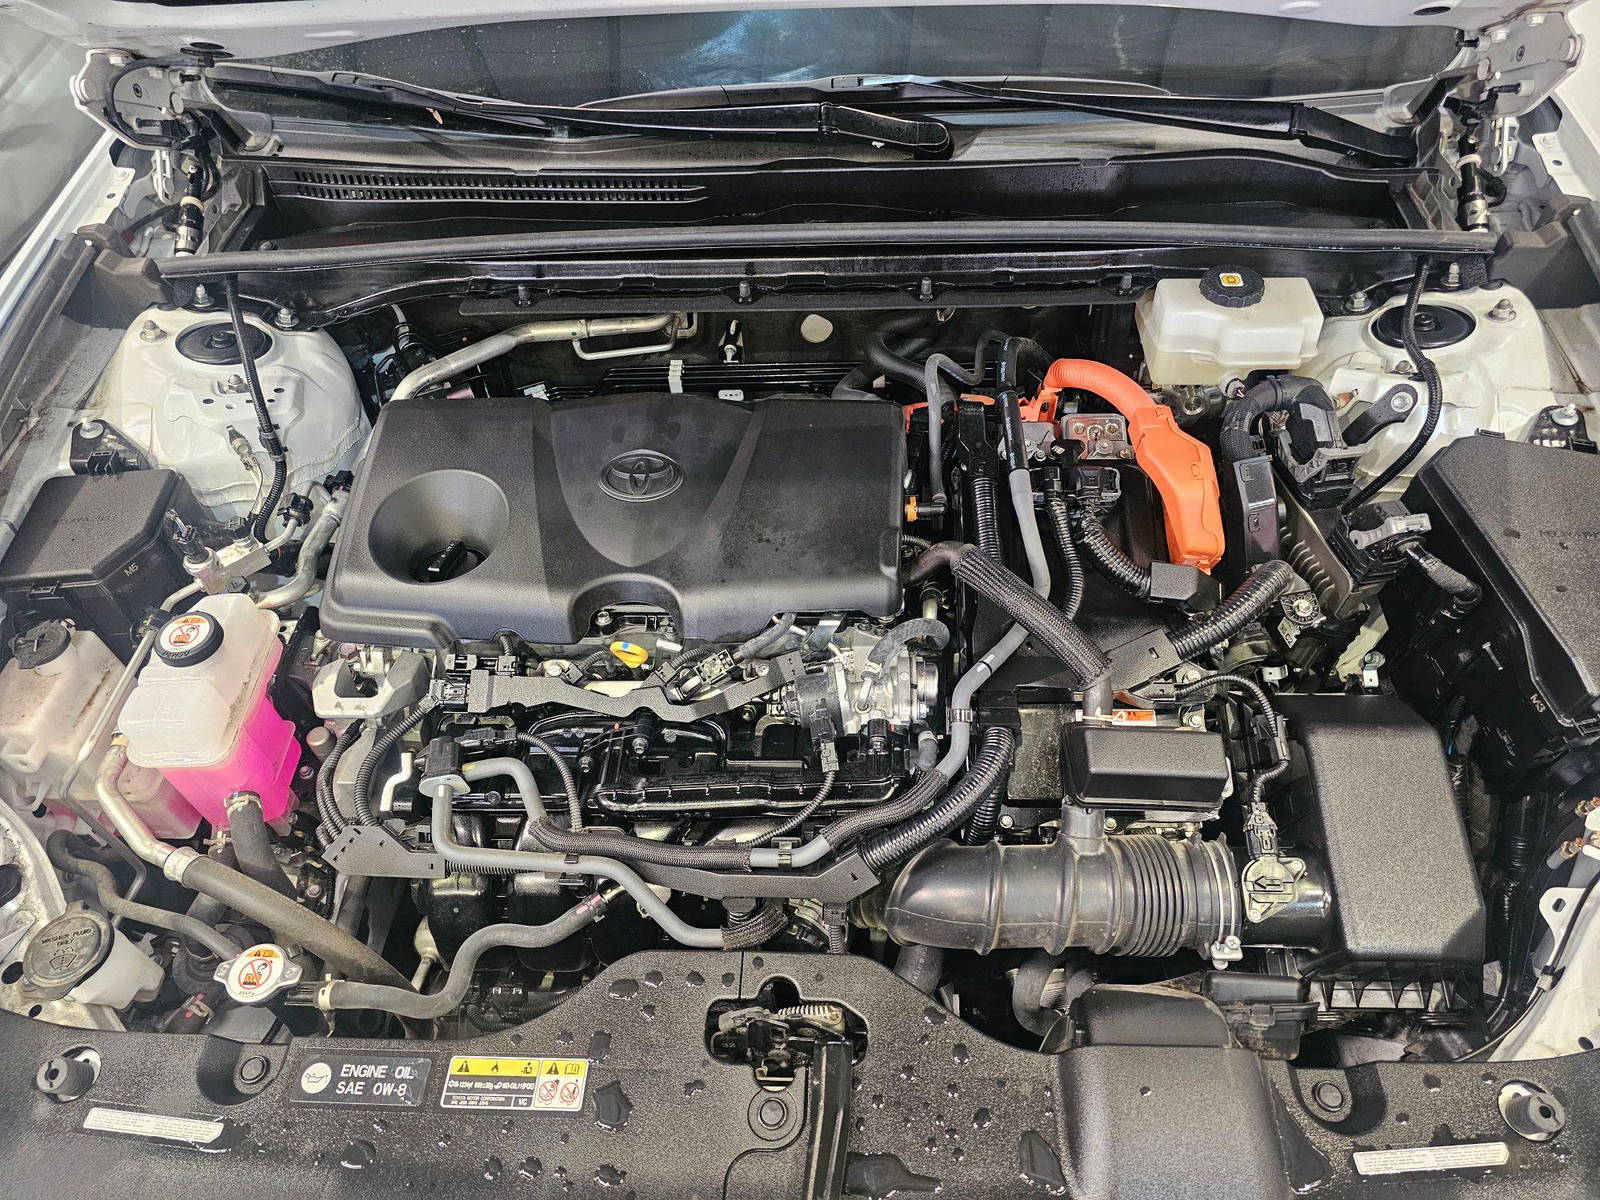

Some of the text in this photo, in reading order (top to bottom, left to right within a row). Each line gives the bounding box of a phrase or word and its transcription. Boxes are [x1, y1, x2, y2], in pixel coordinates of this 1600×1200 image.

[41, 928, 94, 945] WASHER FLUID
[56, 938, 74, 946] ONLY
[340, 1063, 414, 1079] ENGINE OIL
[335, 1081, 408, 1097] SAE 0W-8
